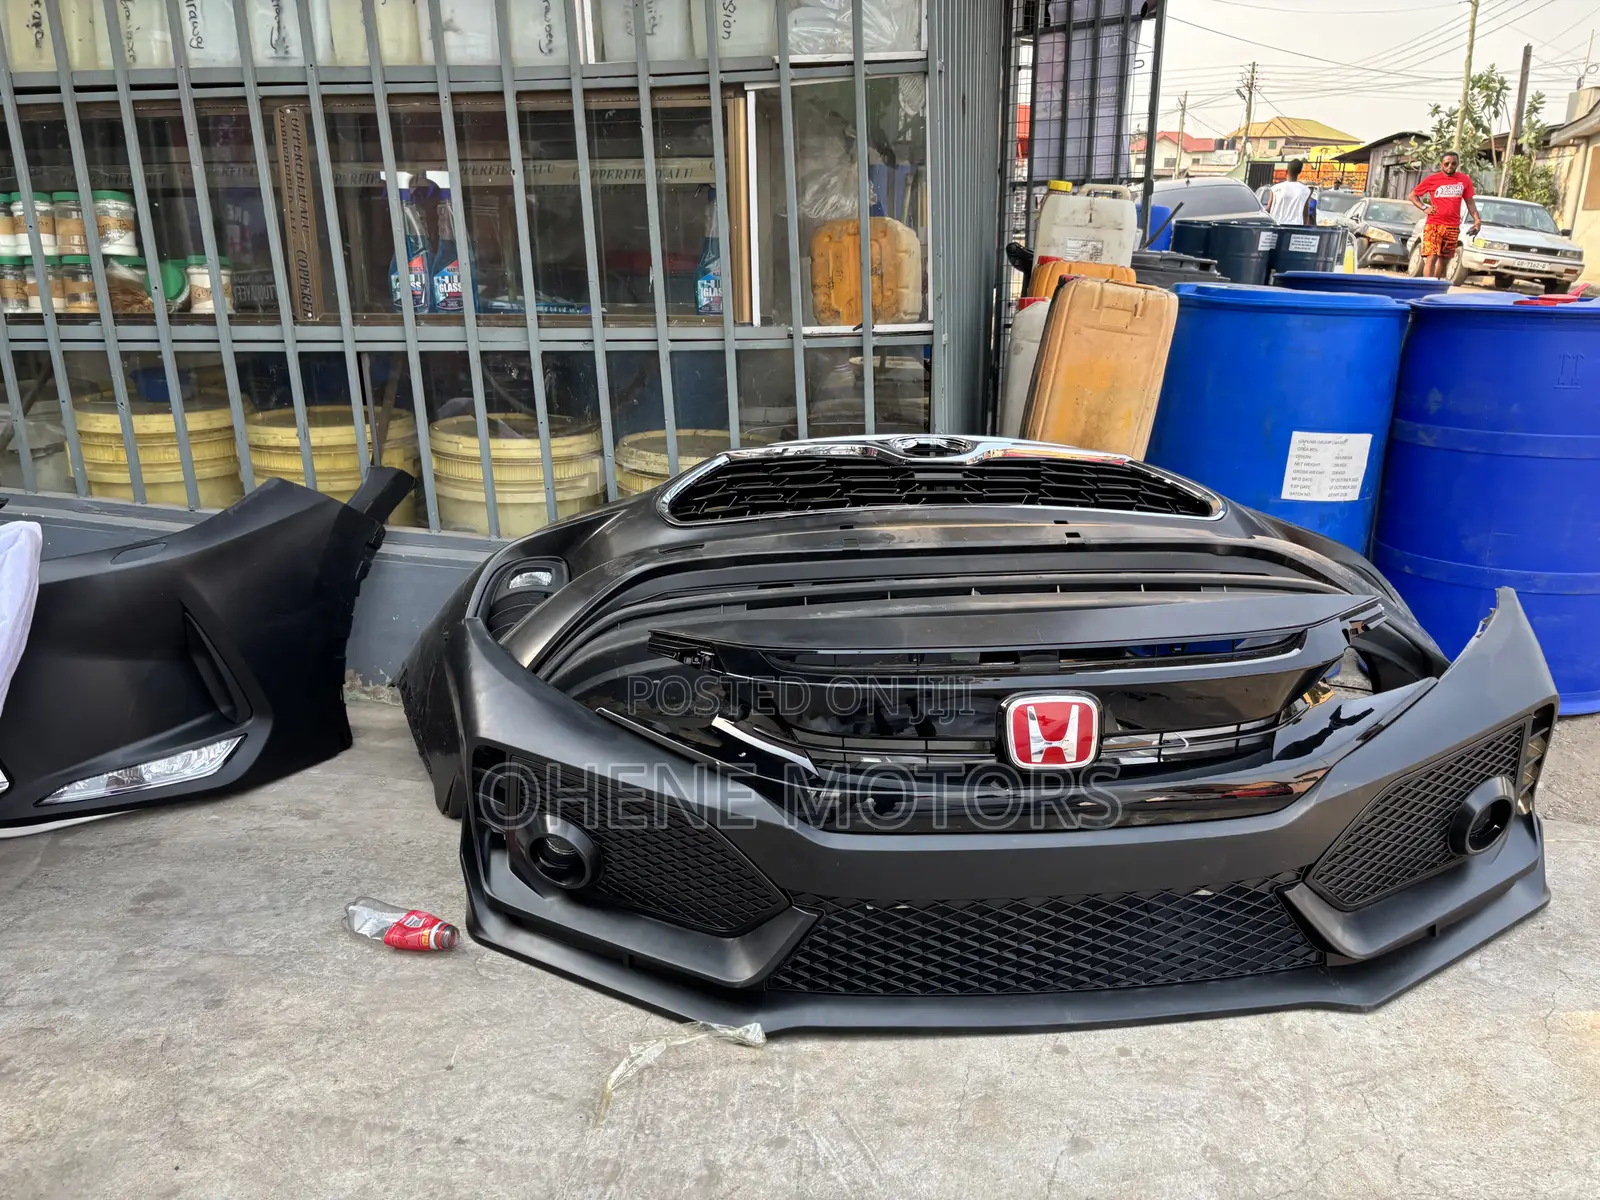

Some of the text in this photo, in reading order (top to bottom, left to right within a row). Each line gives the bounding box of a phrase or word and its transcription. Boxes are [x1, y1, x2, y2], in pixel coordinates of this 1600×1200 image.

[185, 0, 205, 49] raway
[721, 0, 737, 40] sion
[703, 287, 722, 297] GLAS
